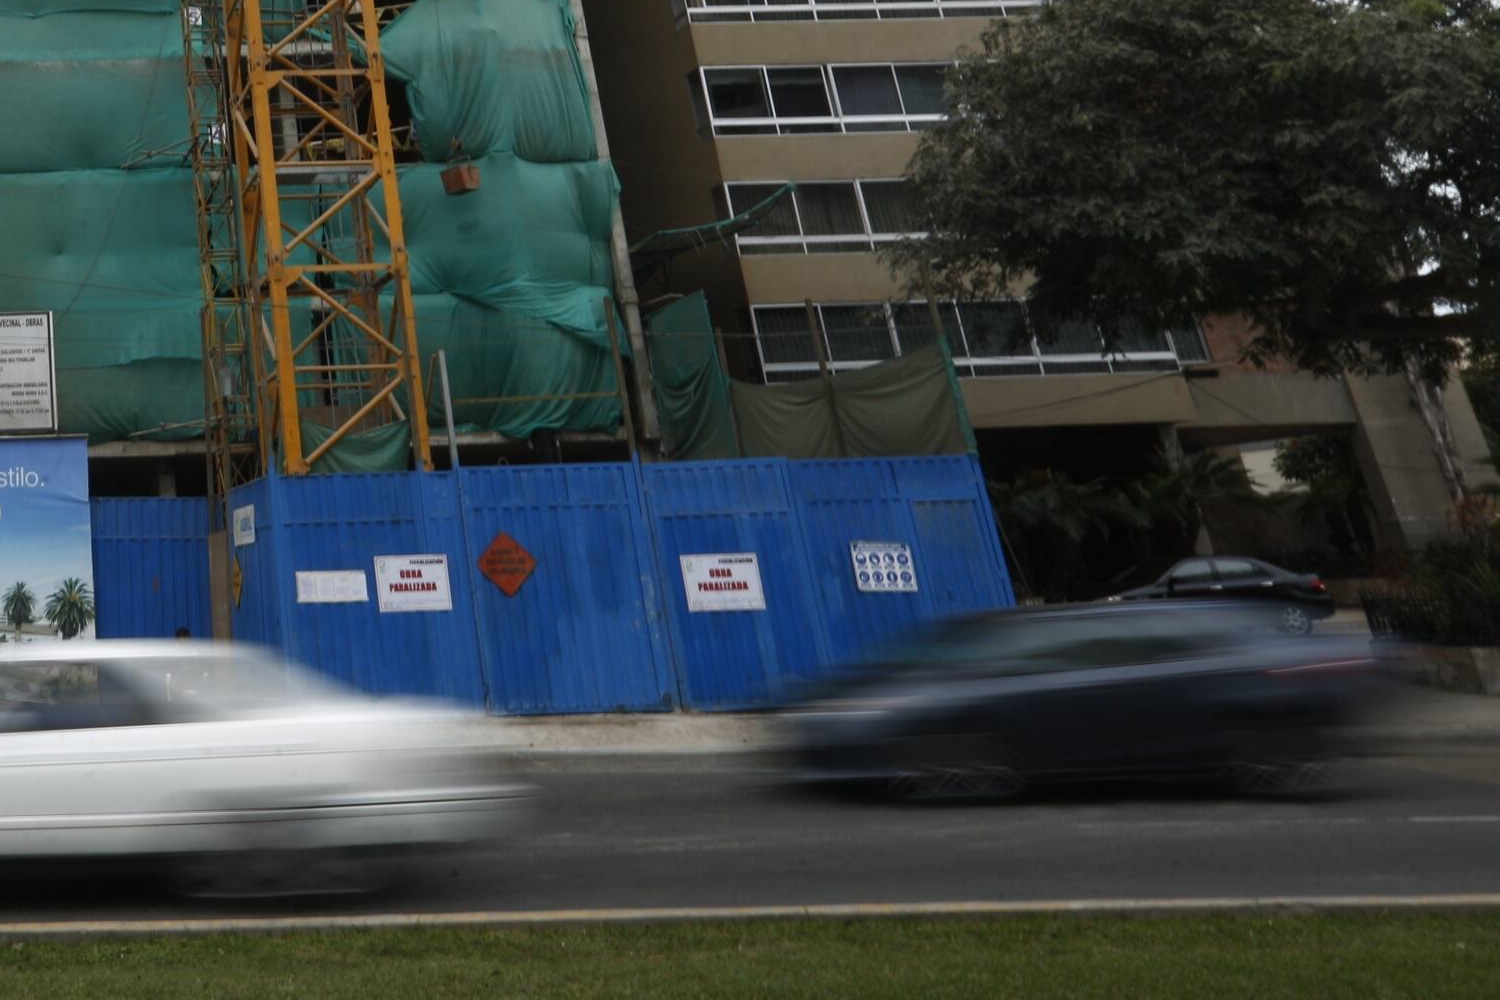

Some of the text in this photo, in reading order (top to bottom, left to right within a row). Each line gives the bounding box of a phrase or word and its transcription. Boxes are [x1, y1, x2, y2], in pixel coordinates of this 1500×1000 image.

[0, 318, 21, 328] VECINAL
[26, 317, 43, 327] OBRAS
[400, 569, 422, 579] OBRA
[709, 568, 732, 578] OBRA
[389, 582, 437, 592] PARALIZADA
[698, 581, 749, 592] PARALIZADA
